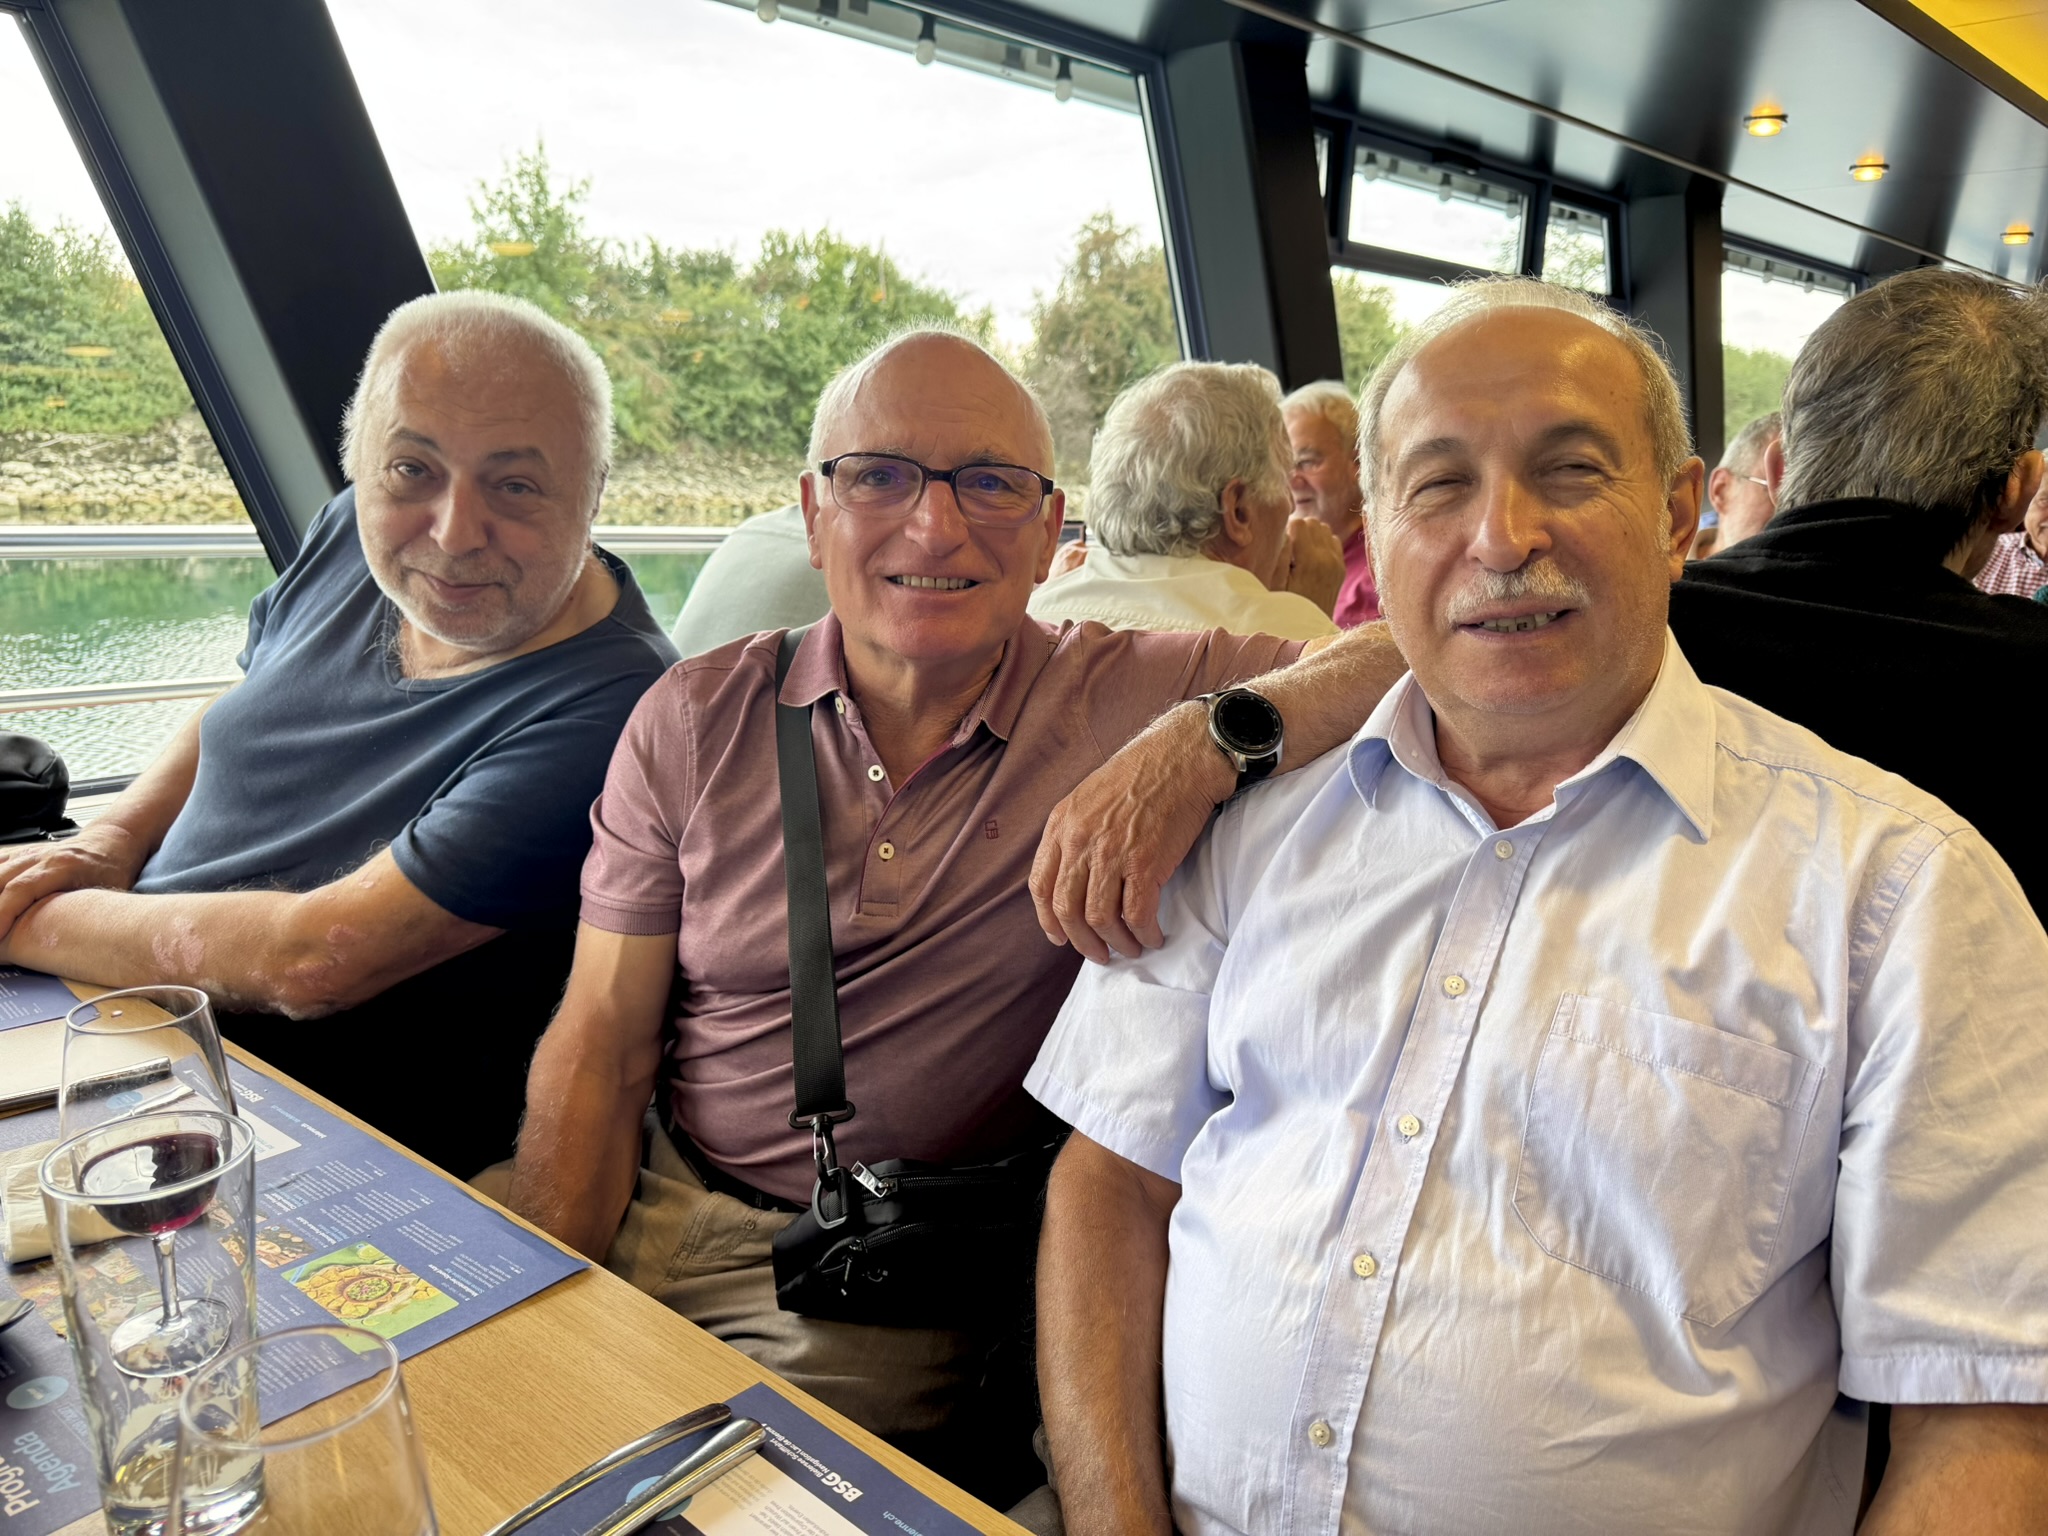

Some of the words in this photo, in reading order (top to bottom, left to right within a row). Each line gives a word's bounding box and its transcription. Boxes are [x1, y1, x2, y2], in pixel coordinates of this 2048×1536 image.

[765, 1426, 785, 1442] Bienne
[783, 1439, 792, 1447] de
[790, 1443, 802, 1454] Lac
[14, 1431, 81, 1493] Agenda
[797, 1458, 824, 1478] Bielersee
[800, 1451, 831, 1474] Navigation
[821, 1472, 864, 1503] BSG
